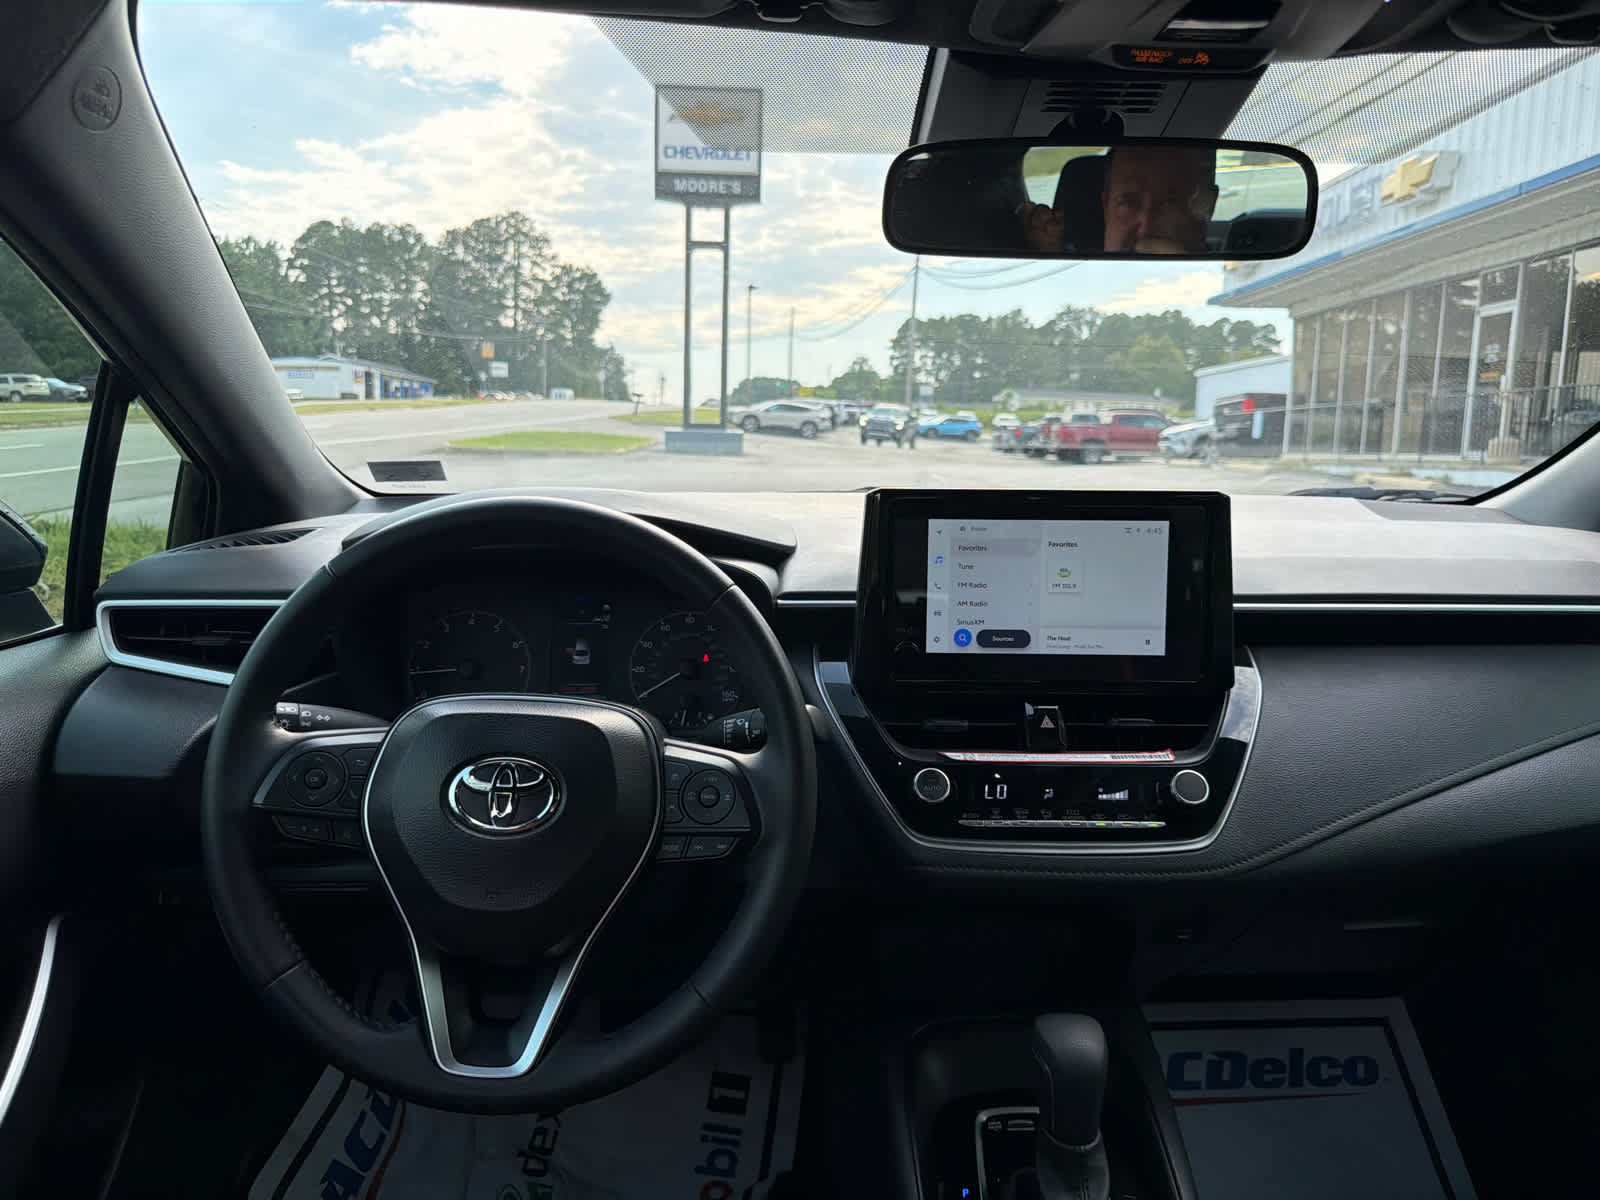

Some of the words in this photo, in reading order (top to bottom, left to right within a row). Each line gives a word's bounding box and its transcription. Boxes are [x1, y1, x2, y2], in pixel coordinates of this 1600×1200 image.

[663, 145, 752, 161] CHEVROLET
[673, 177, 742, 194] MOORE'S
[958, 544, 988, 552] Favorites
[1167, 1047, 1379, 1091] CDelco
